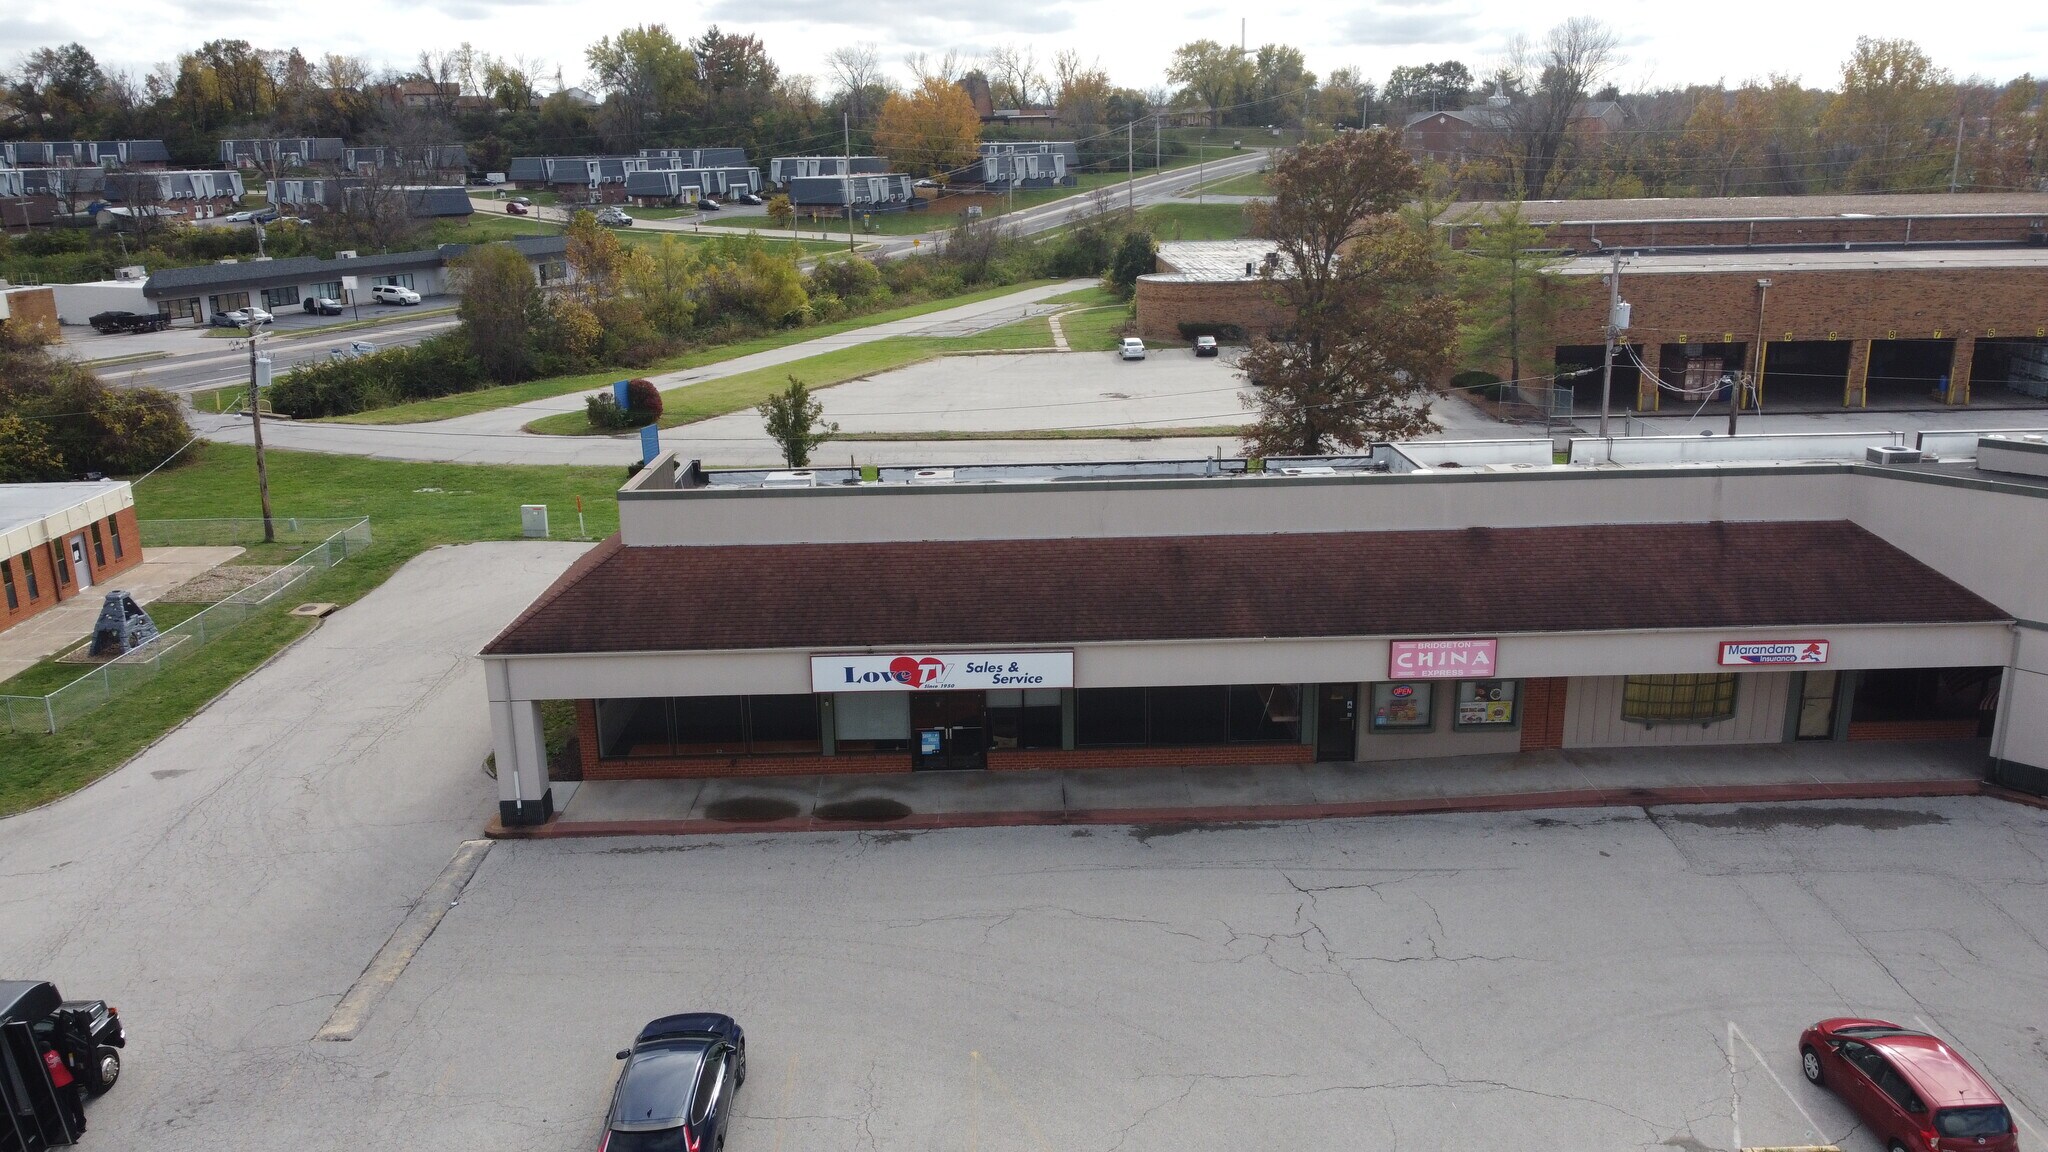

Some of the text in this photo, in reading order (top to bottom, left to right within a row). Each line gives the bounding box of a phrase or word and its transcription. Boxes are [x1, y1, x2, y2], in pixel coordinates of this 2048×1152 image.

[1418, 641, 1471, 649] BRIDGETON
[1728, 645, 1794, 655] Marandam
[1397, 651, 1489, 668] CHINA
[966, 661, 1019, 673] Sales &
[1421, 669, 1464, 677] EXPRESS
[843, 663, 955, 684] Love TV
[992, 672, 1043, 685] Service
